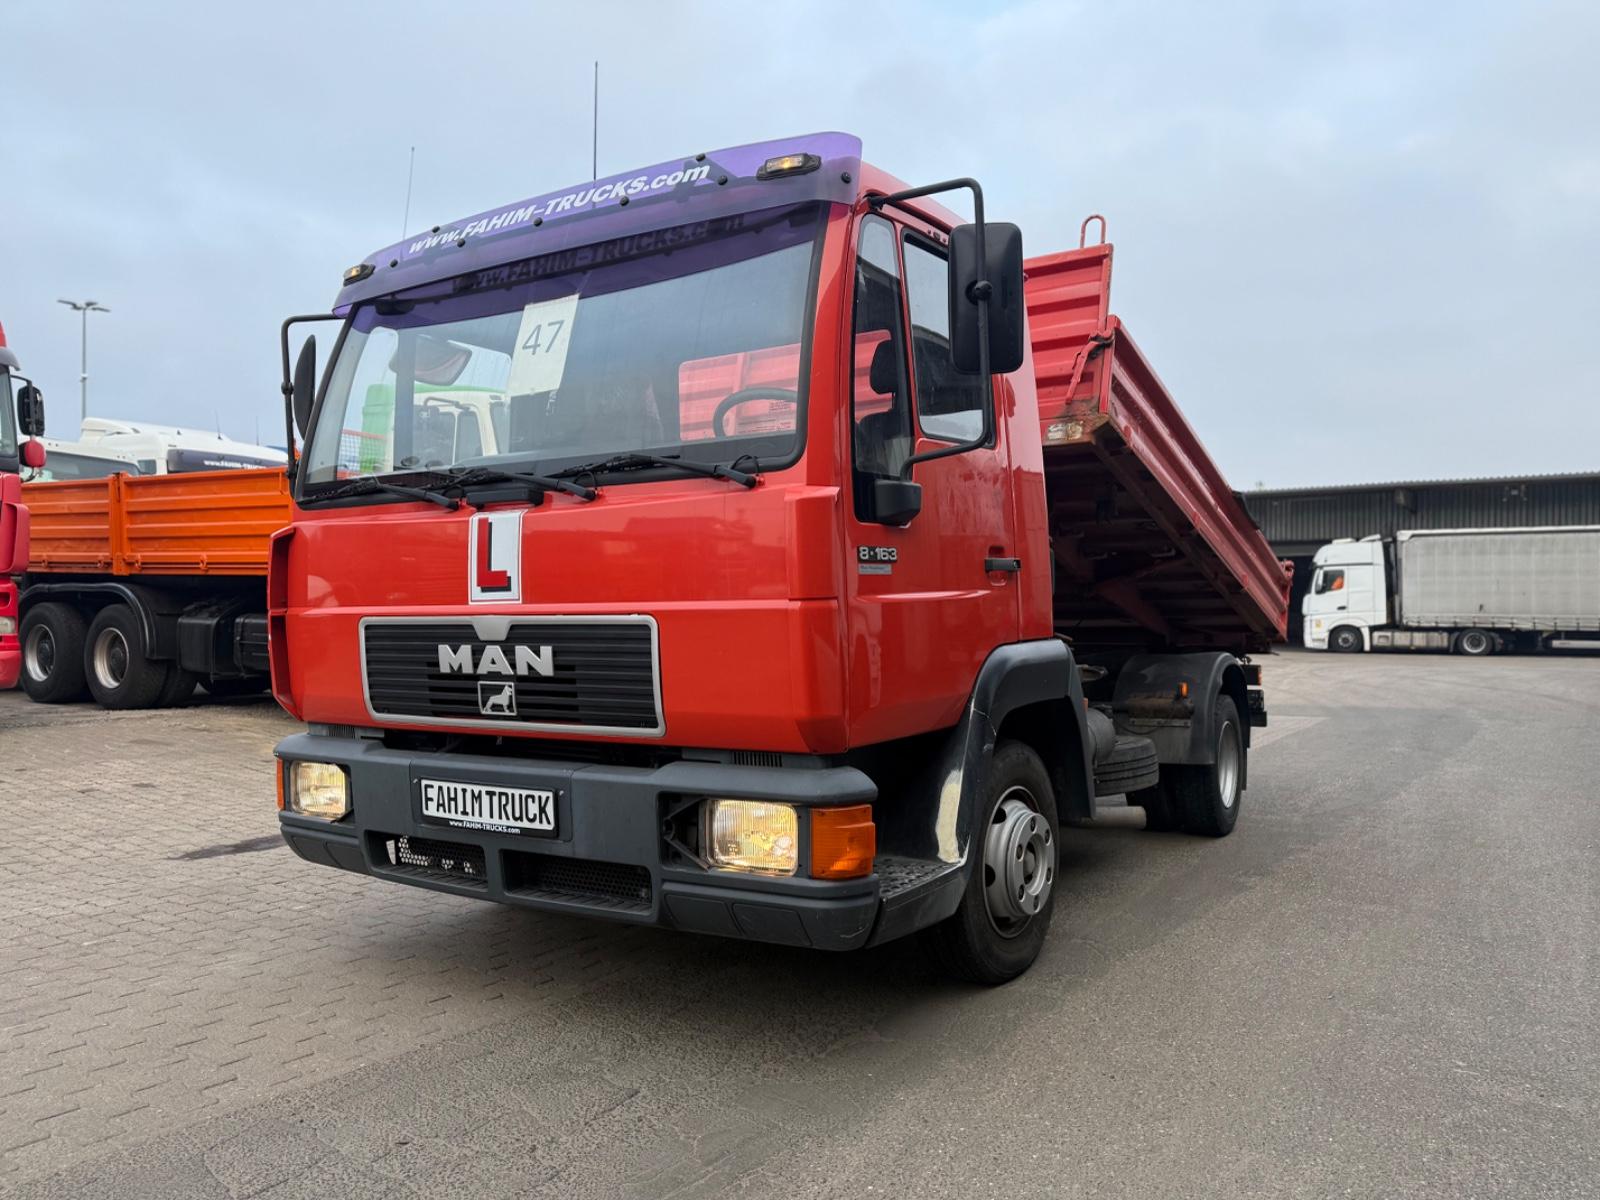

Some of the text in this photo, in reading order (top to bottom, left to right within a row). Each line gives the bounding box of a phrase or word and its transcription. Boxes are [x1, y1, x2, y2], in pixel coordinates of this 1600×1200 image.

[408, 164, 710, 255] www.FAHIM-TRUCKS.com
[522, 319, 566, 356] 47
[477, 516, 512, 592] L
[437, 644, 555, 677] MAN
[423, 783, 552, 826] FAHIMTRUCK
[449, 819, 521, 835] www.FAHIM-TRUCKS.com
